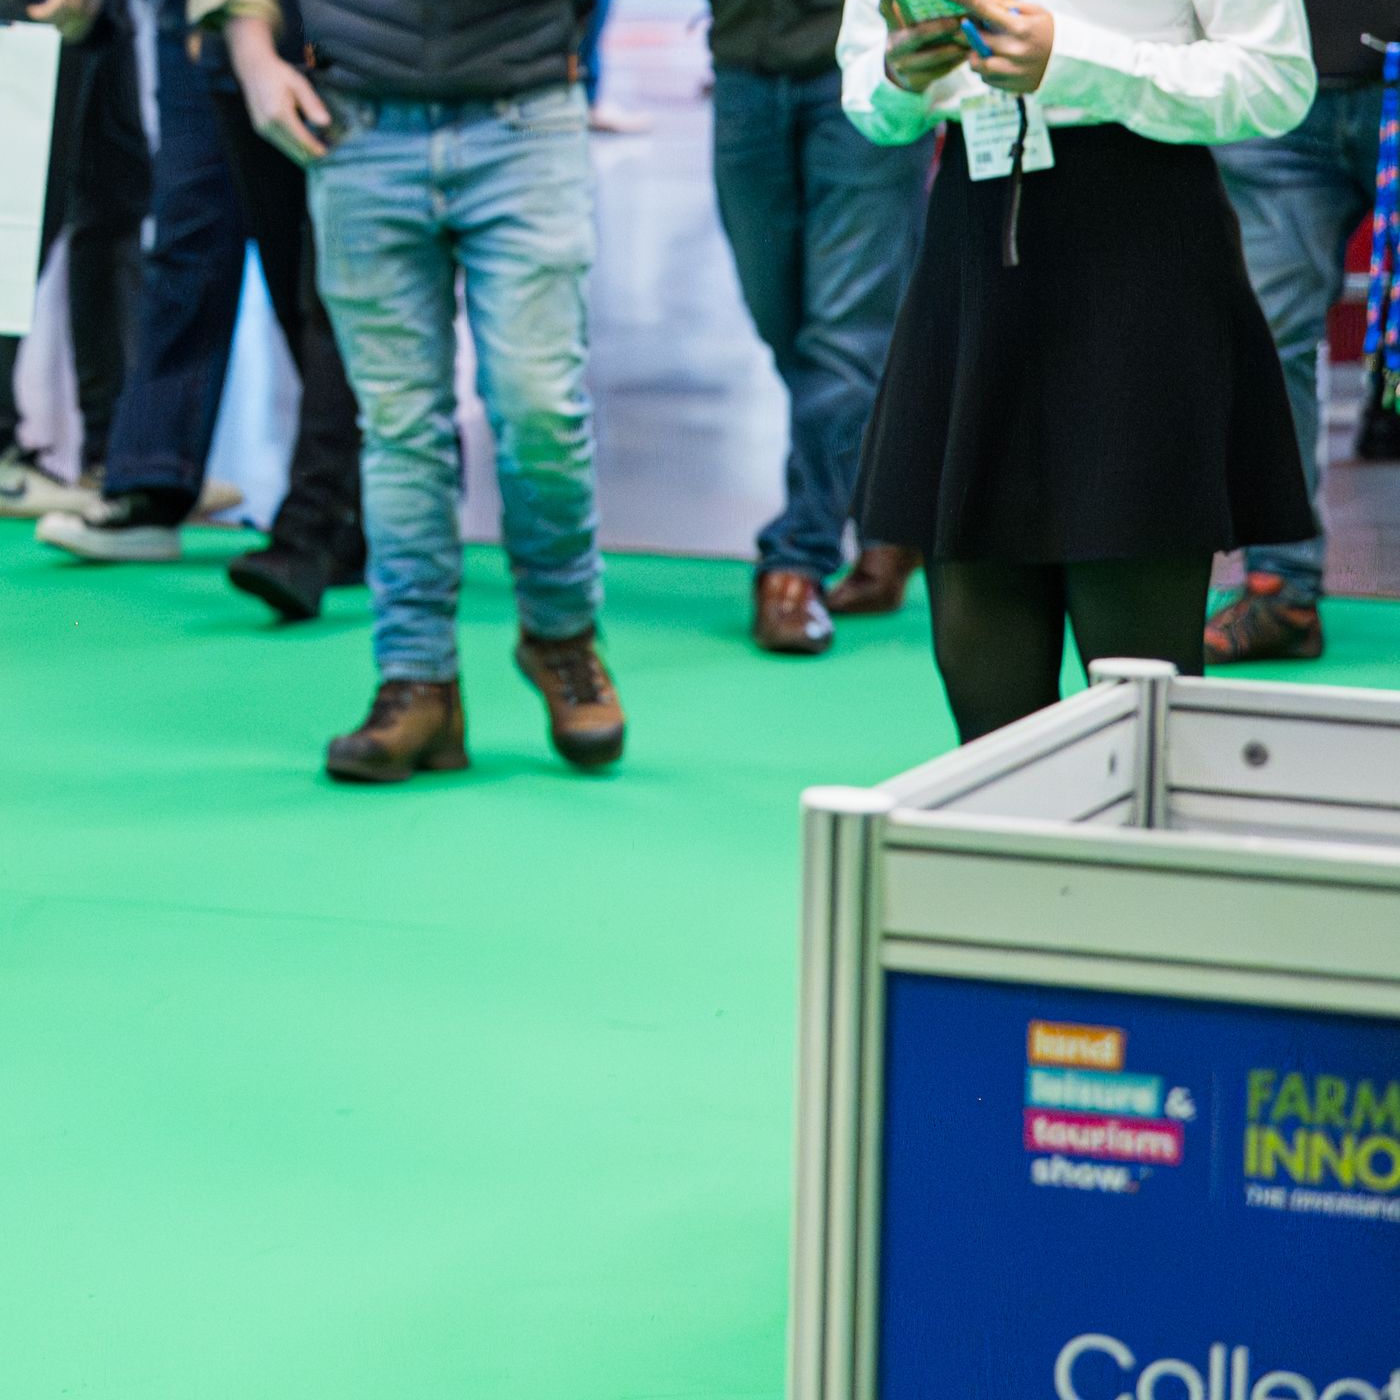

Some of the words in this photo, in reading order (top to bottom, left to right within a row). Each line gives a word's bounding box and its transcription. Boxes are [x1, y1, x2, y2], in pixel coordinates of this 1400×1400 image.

[1164, 1086, 1197, 1122] &
[1247, 1068, 1400, 1131] FARM
[1032, 1117, 1177, 1159] tourism
[1244, 1125, 1400, 1191] INNO
